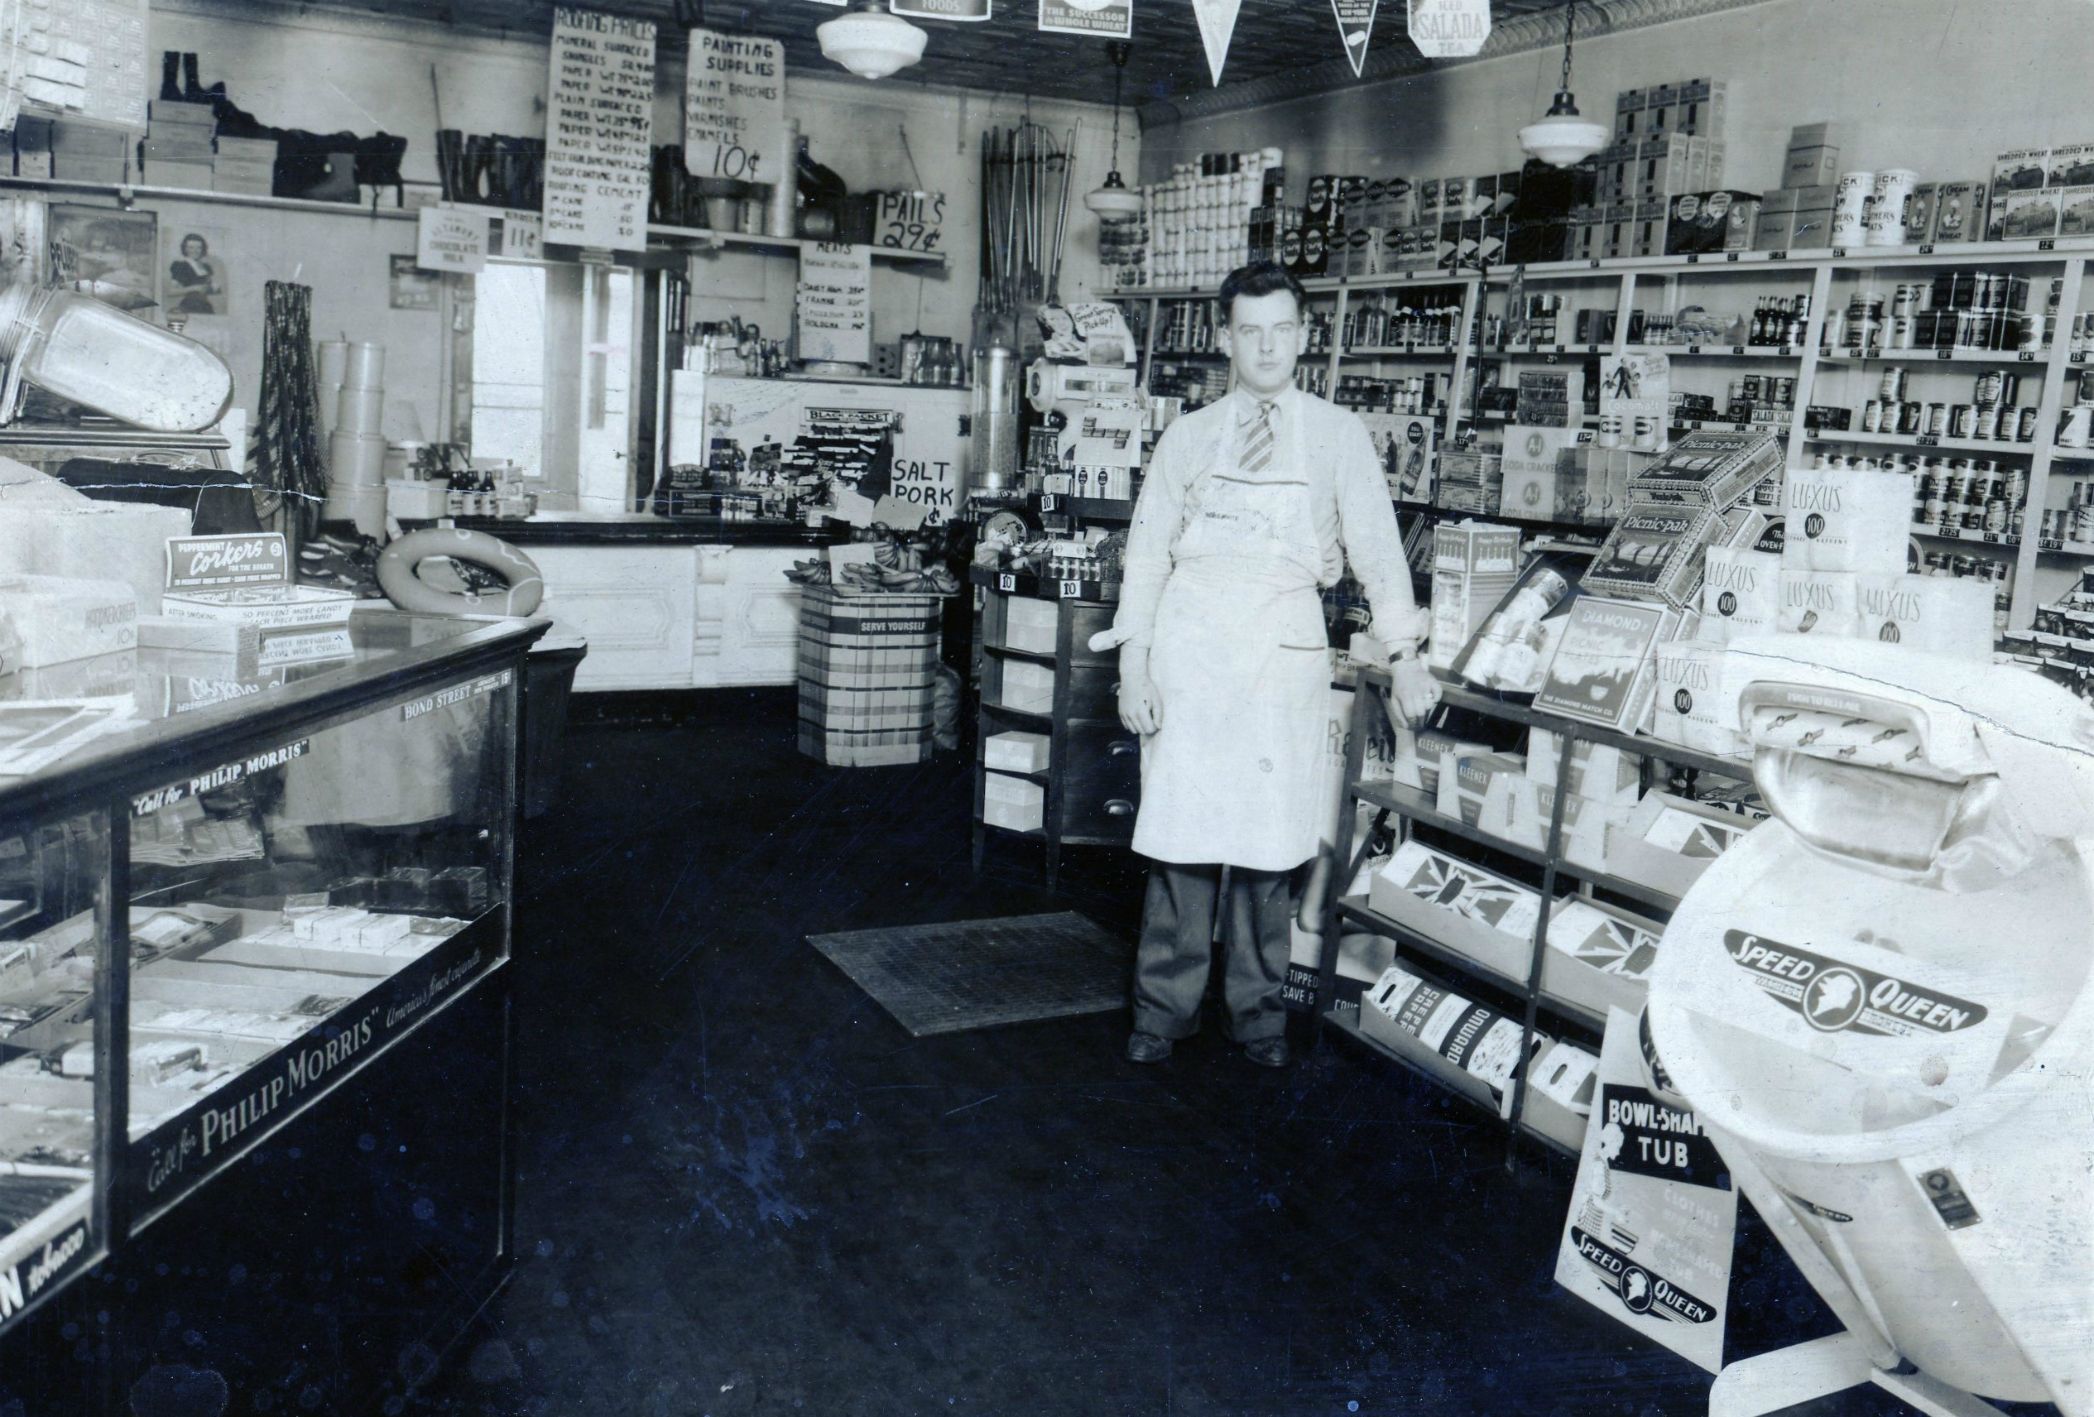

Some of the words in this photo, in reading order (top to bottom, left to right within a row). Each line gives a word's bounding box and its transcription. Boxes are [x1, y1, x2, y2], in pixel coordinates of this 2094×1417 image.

[1046, 7, 1065, 16] THE
[1068, 9, 1126, 22] SUCCESSOR
[557, 9, 608, 33] ROOFING
[611, 18, 657, 41] PRICES
[1054, 18, 1090, 28] WHOLE
[1092, 20, 1127, 31] WHEAT
[1419, 13, 1484, 40] SALADA
[703, 37, 773, 58] PAINTING
[1439, 43, 1465, 54] TEA
[706, 57, 774, 76] SUPPLIES
[690, 78, 721, 91] PAINT
[729, 83, 777, 100] BRUSHES
[689, 94, 725, 109] PAINTS
[687, 112, 747, 131] VARNISHES
[688, 128, 739, 145] ENAMELS
[1998, 152, 2026, 161] SHREDDED
[2052, 148, 2081, 156] SHREDDED
[714, 145, 760, 182] 10¢
[597, 186, 642, 199] CEMENT
[1914, 186, 1933, 196] CREAM
[1946, 185, 1969, 196] CREAM
[882, 195, 946, 224] PAILS
[883, 222, 940, 252] 29¢
[1938, 232, 1962, 240] WHEAT
[817, 242, 851, 255] MEATS
[1607, 400, 1659, 413] Cocomalt
[1680, 440, 1747, 450] Picnic-pak
[892, 460, 950, 482] SALT
[1504, 461, 1524, 469] SODA
[895, 485, 954, 507] PORK
[1792, 483, 1843, 512] LUXUS
[1624, 516, 1688, 533] Picnic-pak
[1807, 516, 1823, 533] 100
[178, 541, 226, 553] PEPPERMINT
[1760, 541, 1784, 550] OVEN-F
[190, 540, 263, 577] Corkers
[252, 563, 274, 571] BREATH
[1002, 575, 1013, 589] 10
[1708, 562, 1756, 592] LUXUS
[1064, 581, 1077, 596] 10
[1787, 582, 1835, 612] LUXUS
[257, 609, 290, 618] PERCENT
[293, 606, 314, 615] MORE
[317, 604, 343, 613] CANDY
[1721, 596, 1735, 612] 100
[1867, 588, 1922, 623] LUXUS
[273, 616, 292, 624] PIECE
[297, 613, 332, 622] WRAPPED
[861, 621, 887, 632] SERVE
[888, 620, 926, 632] YOURSELF
[1582, 611, 1641, 631] DIAMOND
[1663, 660, 1710, 691] LUXUS
[405, 698, 433, 720] BOND
[437, 685, 471, 708] STREET
[1543, 694, 1553, 703] THE
[1554, 696, 1581, 708] DIAMOND
[1582, 702, 1602, 713] MATCH
[1603, 708, 1613, 717] CO.
[1677, 693, 1691, 709] 100
[1417, 737, 1450, 753] KLEENEX
[190, 764, 242, 796] PHILIP
[1459, 765, 1488, 785] KLEENEX
[1541, 791, 1578, 813] KLEEX
[1286, 969, 1319, 988] -TIPPED
[1731, 936, 1816, 981] SPEED
[1869, 978, 1970, 1031] QUEEN
[1283, 985, 1305, 1001] SAVE
[1406, 986, 1441, 1036] CREPE
[1445, 1008, 1491, 1065] ONWARD
[201, 1077, 285, 1157] PHILIP
[1609, 1098, 1705, 1137] BOWL-SHA
[1638, 1136, 1688, 1168] TUB
[28, 1227, 84, 1297] tobacco
[1578, 1233, 1622, 1274] SPEED
[1654, 1278, 1707, 1323] QUEEN
